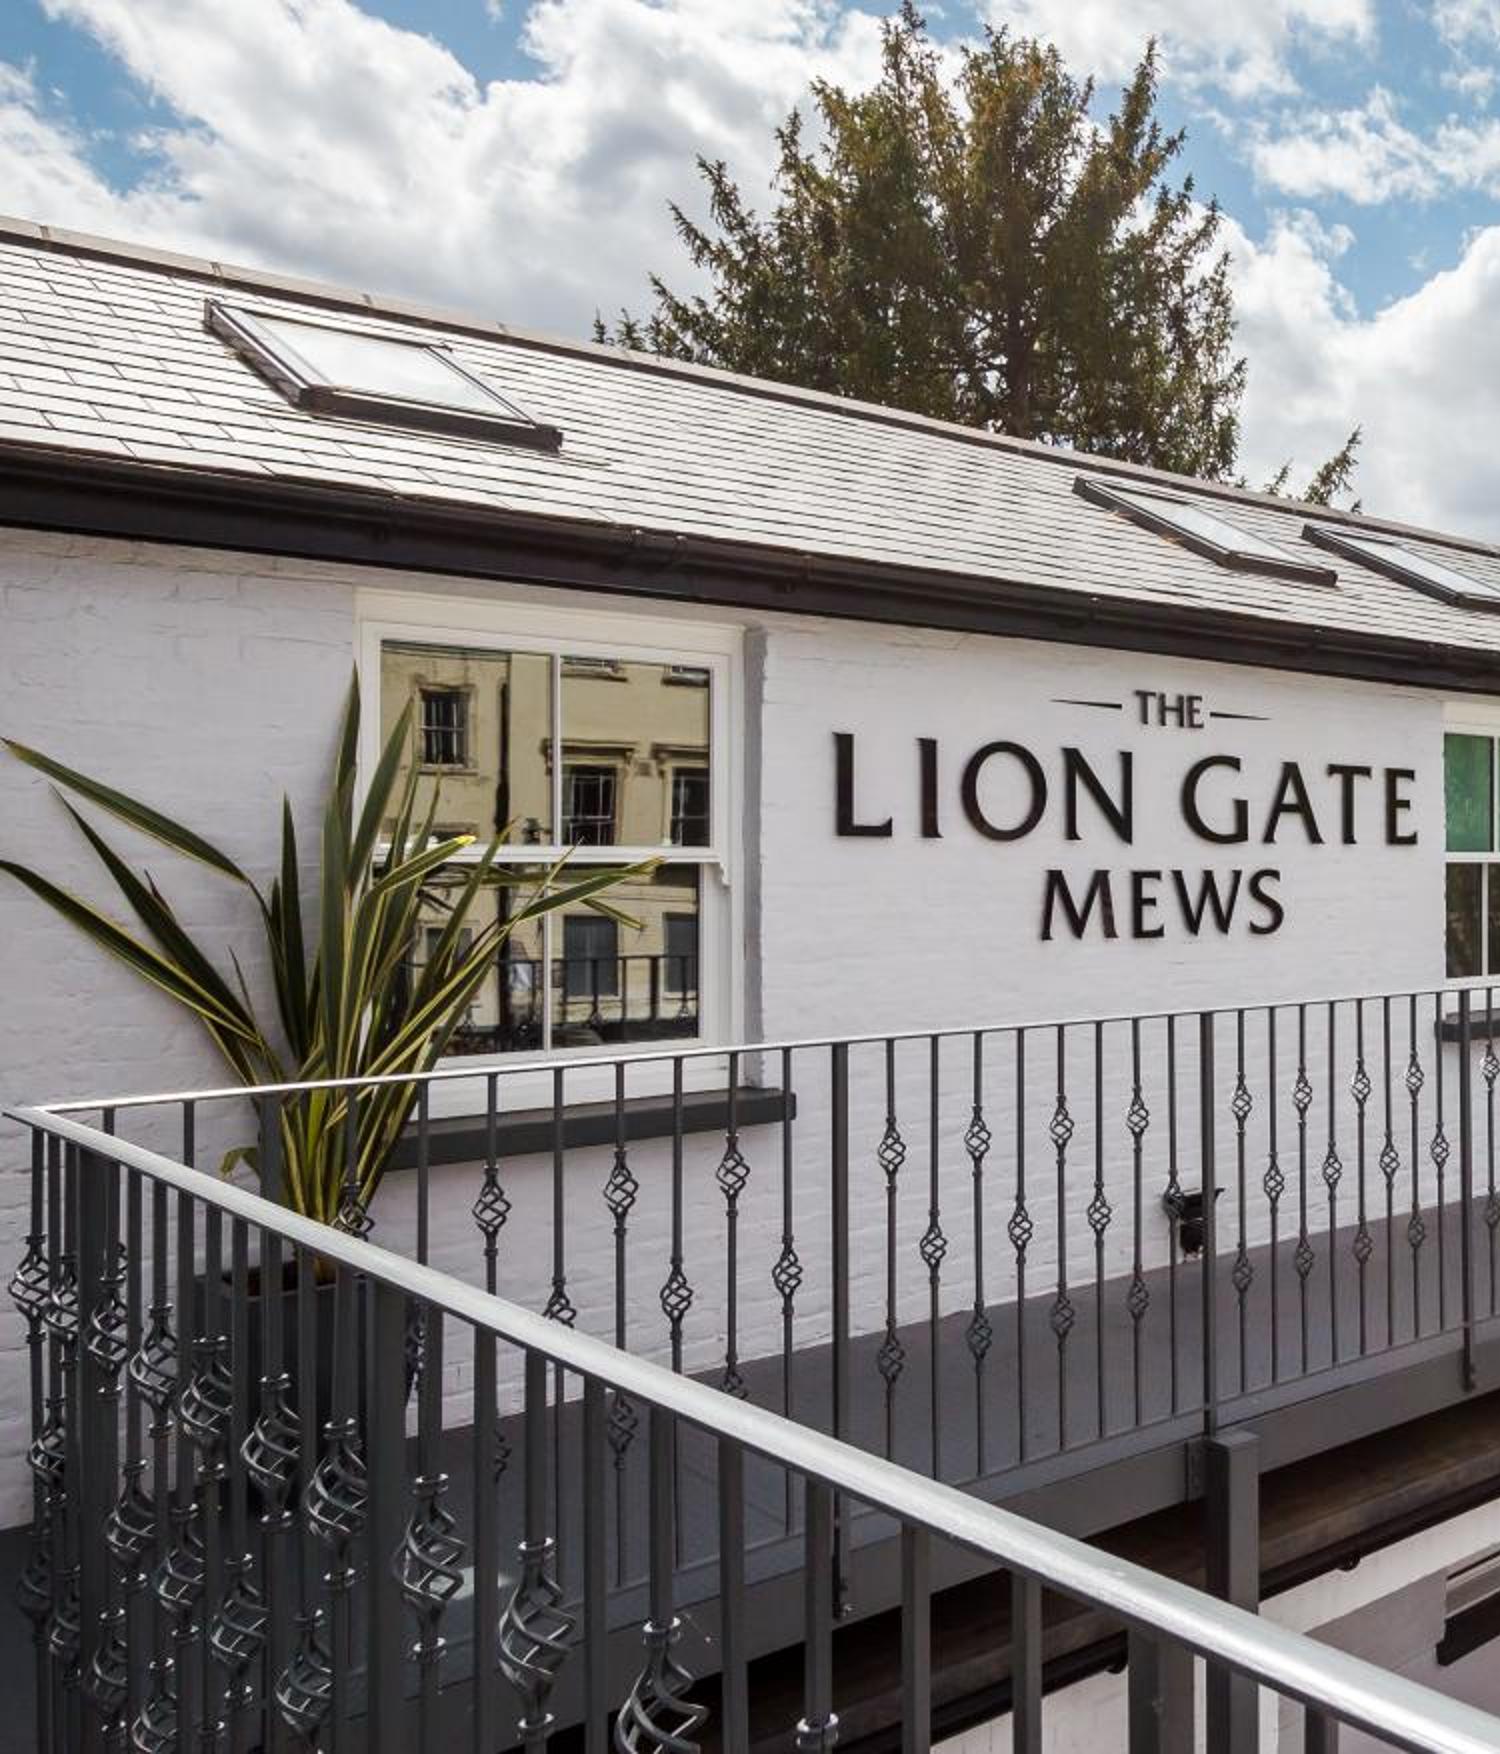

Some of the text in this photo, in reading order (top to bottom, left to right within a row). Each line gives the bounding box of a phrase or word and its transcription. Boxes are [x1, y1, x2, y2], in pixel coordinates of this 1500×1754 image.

[1134, 690, 1205, 728] THE
[831, 732, 1418, 846] LION GATE
[1039, 869, 1285, 941] MEWS
